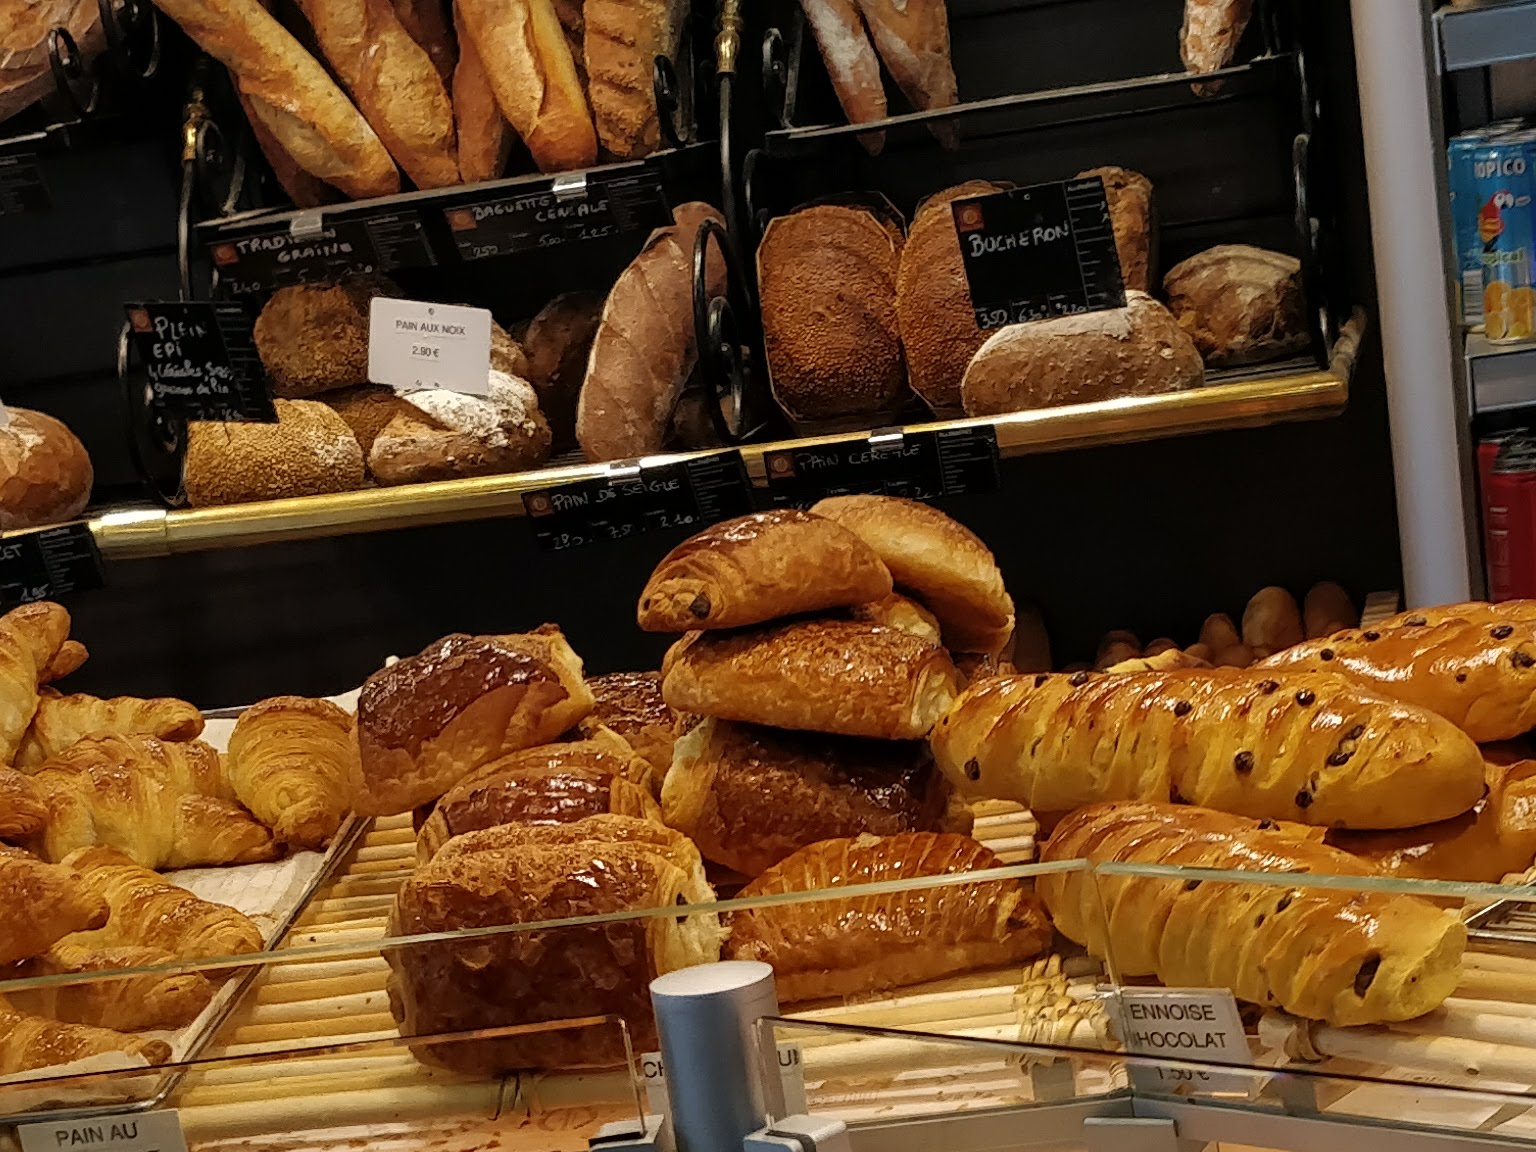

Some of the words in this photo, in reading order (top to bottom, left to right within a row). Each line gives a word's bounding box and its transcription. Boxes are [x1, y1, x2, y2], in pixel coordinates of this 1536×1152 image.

[1473, 157, 1527, 179] OPICO
[472, 195, 551, 221] BAGUETTE
[968, 220, 1070, 258] BUCHERON
[395, 320, 418, 332] PAIN
[420, 322, 439, 334] AUX
[442, 325, 466, 337] NOIX
[152, 341, 183, 359] EPI
[796, 451, 839, 472] PAIN
[552, 491, 589, 512] PAIN
[621, 478, 681, 497] SEIGLE
[1130, 1003, 1217, 1022] ENNOISE
[1134, 1031, 1228, 1050] HOCOLAT
[55, 1125, 105, 1148] PAIN
[109, 1121, 139, 1141] AU
